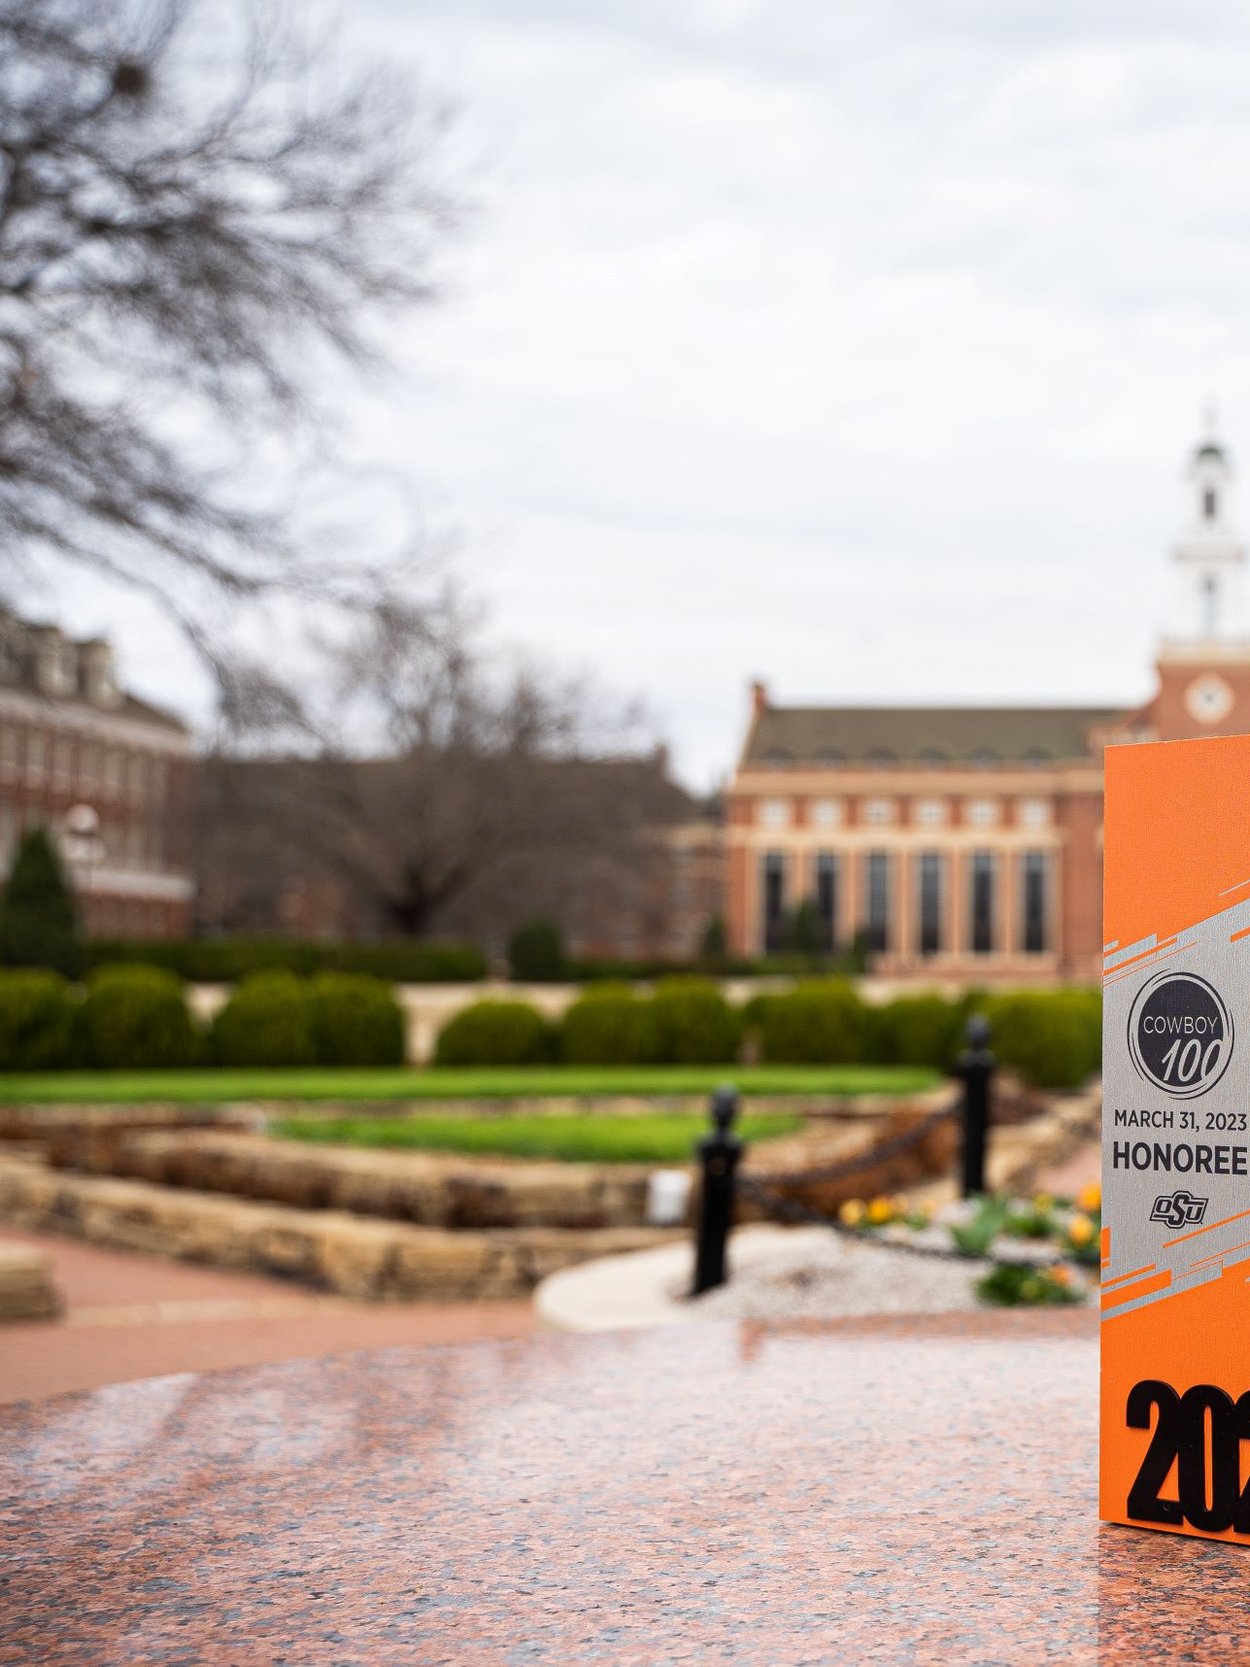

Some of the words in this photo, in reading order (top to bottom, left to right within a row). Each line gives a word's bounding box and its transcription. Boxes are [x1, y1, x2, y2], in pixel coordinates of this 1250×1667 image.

[1143, 1016, 1218, 1034] COWBOY
[1161, 1038, 1224, 1082] 100
[1114, 1109, 1174, 1128] MARCH
[1179, 1111, 1200, 1132] 31,
[1205, 1112, 1247, 1131] 2023
[1112, 1141, 1248, 1175] HONOREE
[1149, 1190, 1209, 1229] OSU
